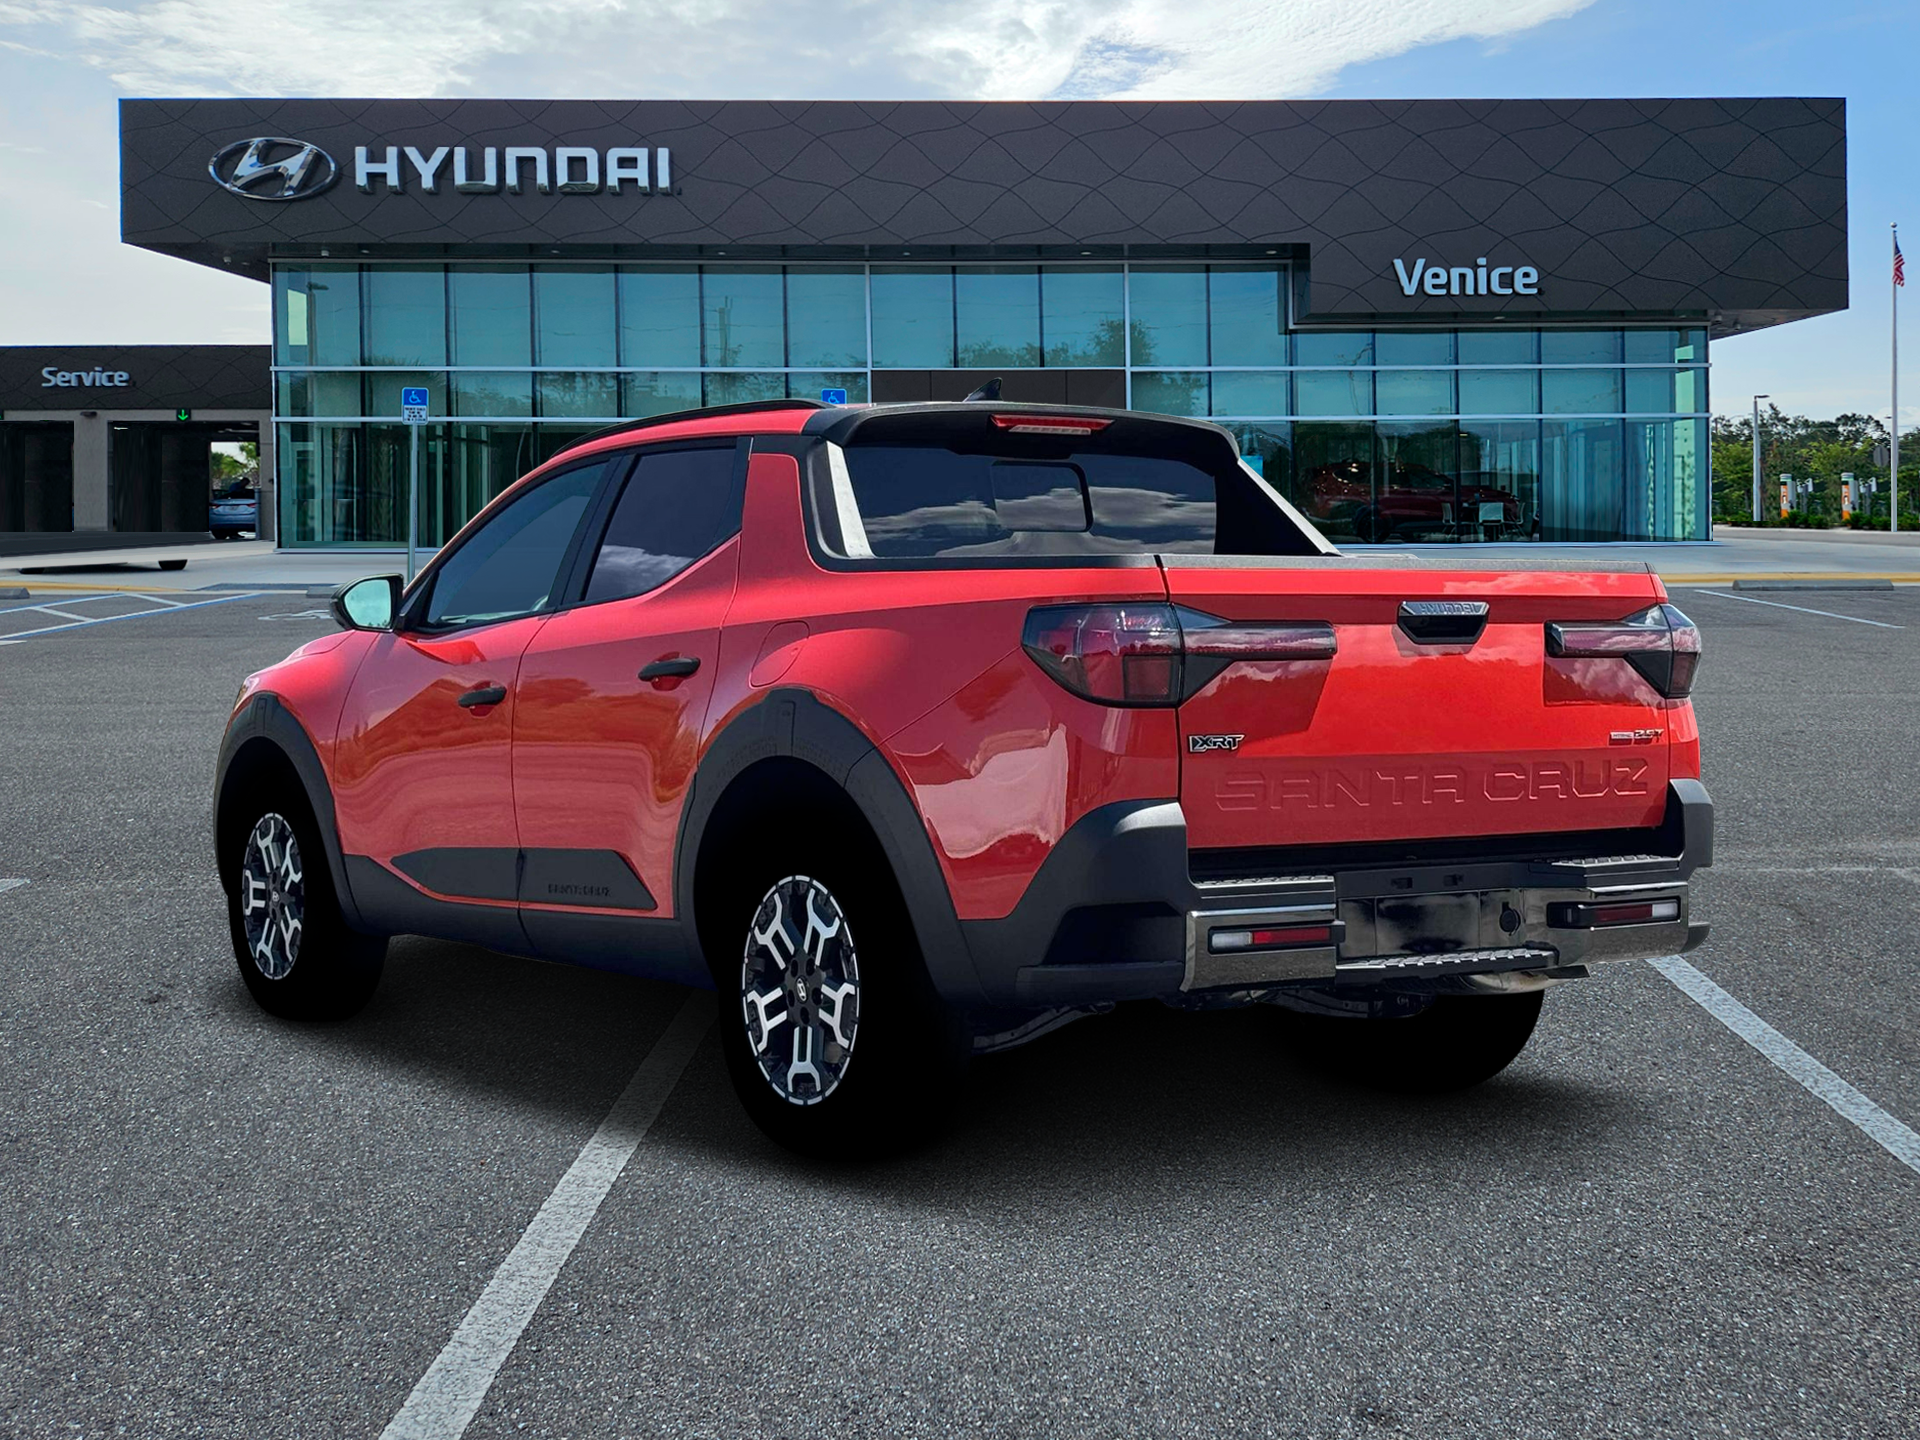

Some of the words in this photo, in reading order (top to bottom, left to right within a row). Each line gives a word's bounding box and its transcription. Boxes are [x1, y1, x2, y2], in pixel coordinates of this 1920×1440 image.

[354, 146, 671, 193] HYUNDAI
[1392, 256, 1539, 297] Venice
[41, 366, 130, 387] Service
[1189, 734, 1245, 752] XRT
[1215, 766, 1466, 812] SANTA
[1483, 757, 1649, 801] CRUZ
